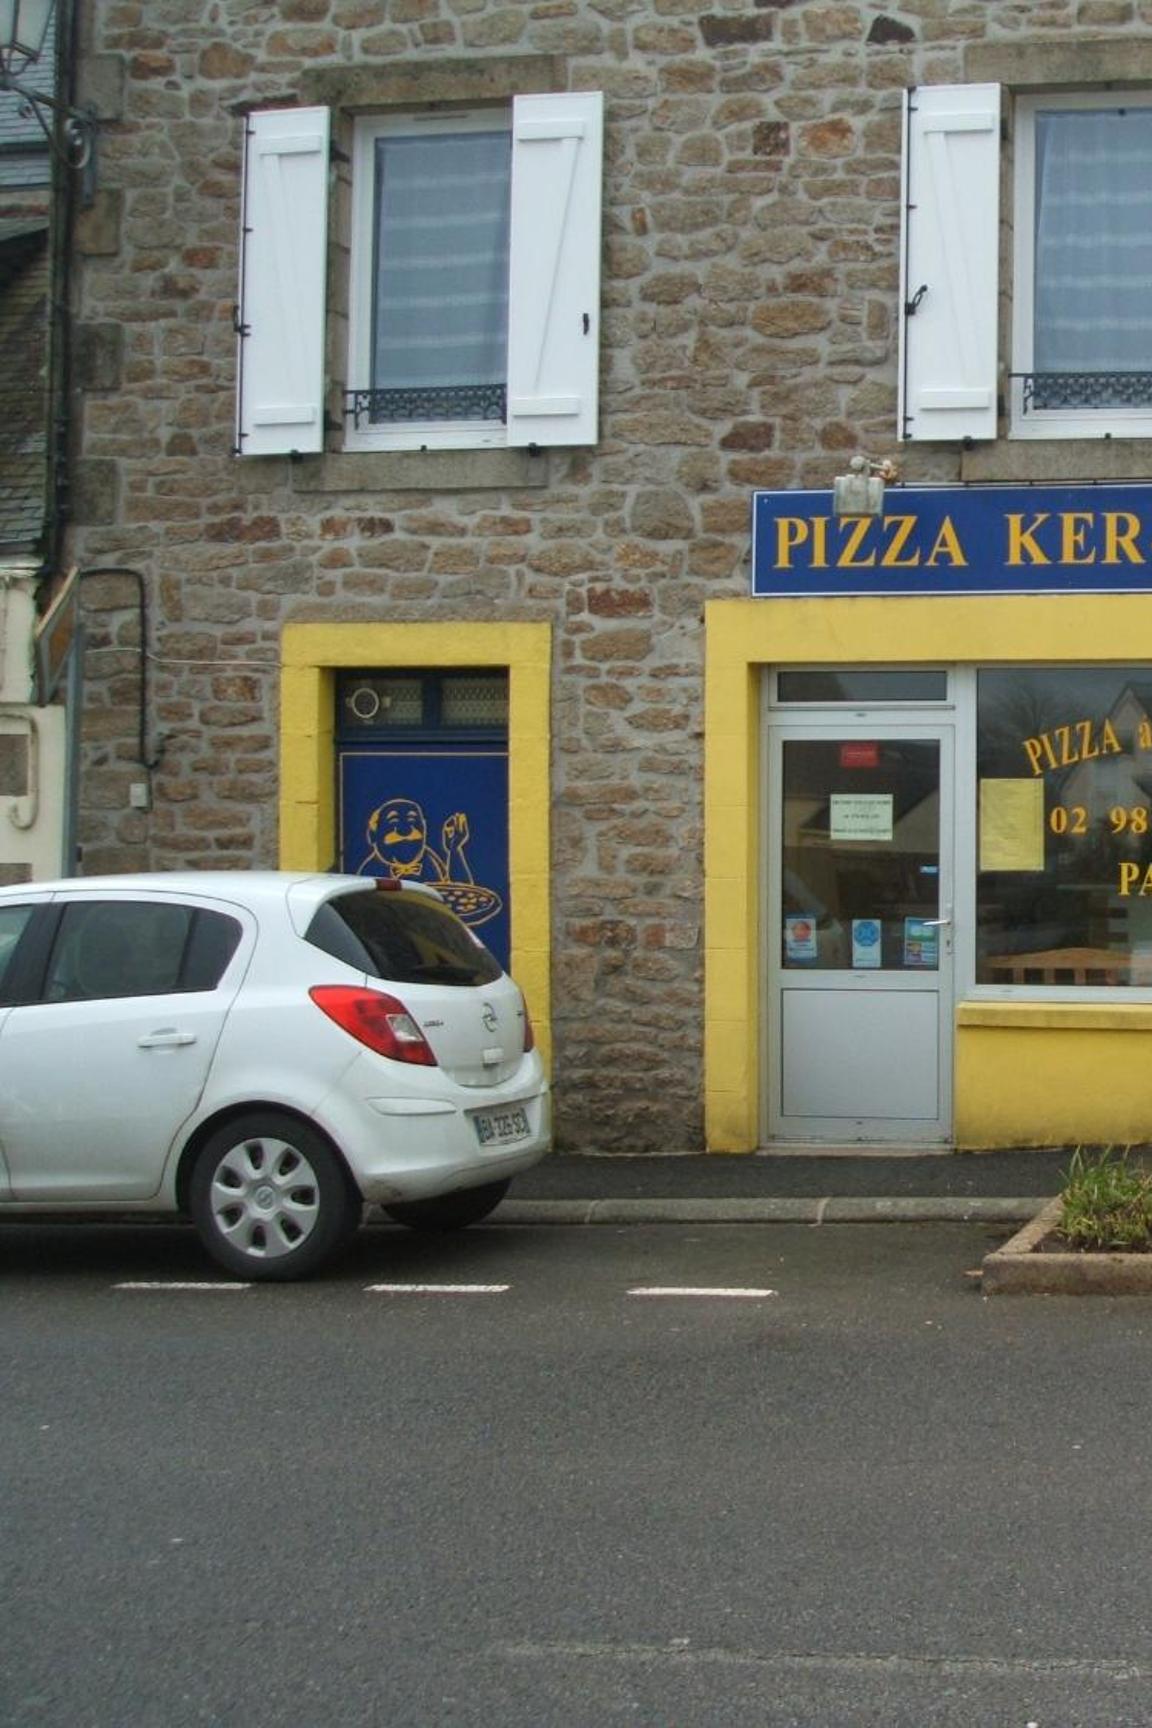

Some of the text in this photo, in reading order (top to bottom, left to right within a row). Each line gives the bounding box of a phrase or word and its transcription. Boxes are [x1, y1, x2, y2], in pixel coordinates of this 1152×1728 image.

[773, 514, 969, 569] PIZZA
[1022, 717, 1122, 776] PIZZA
[1050, 806, 1088, 835] 02
[1110, 806, 1149, 835] 98
